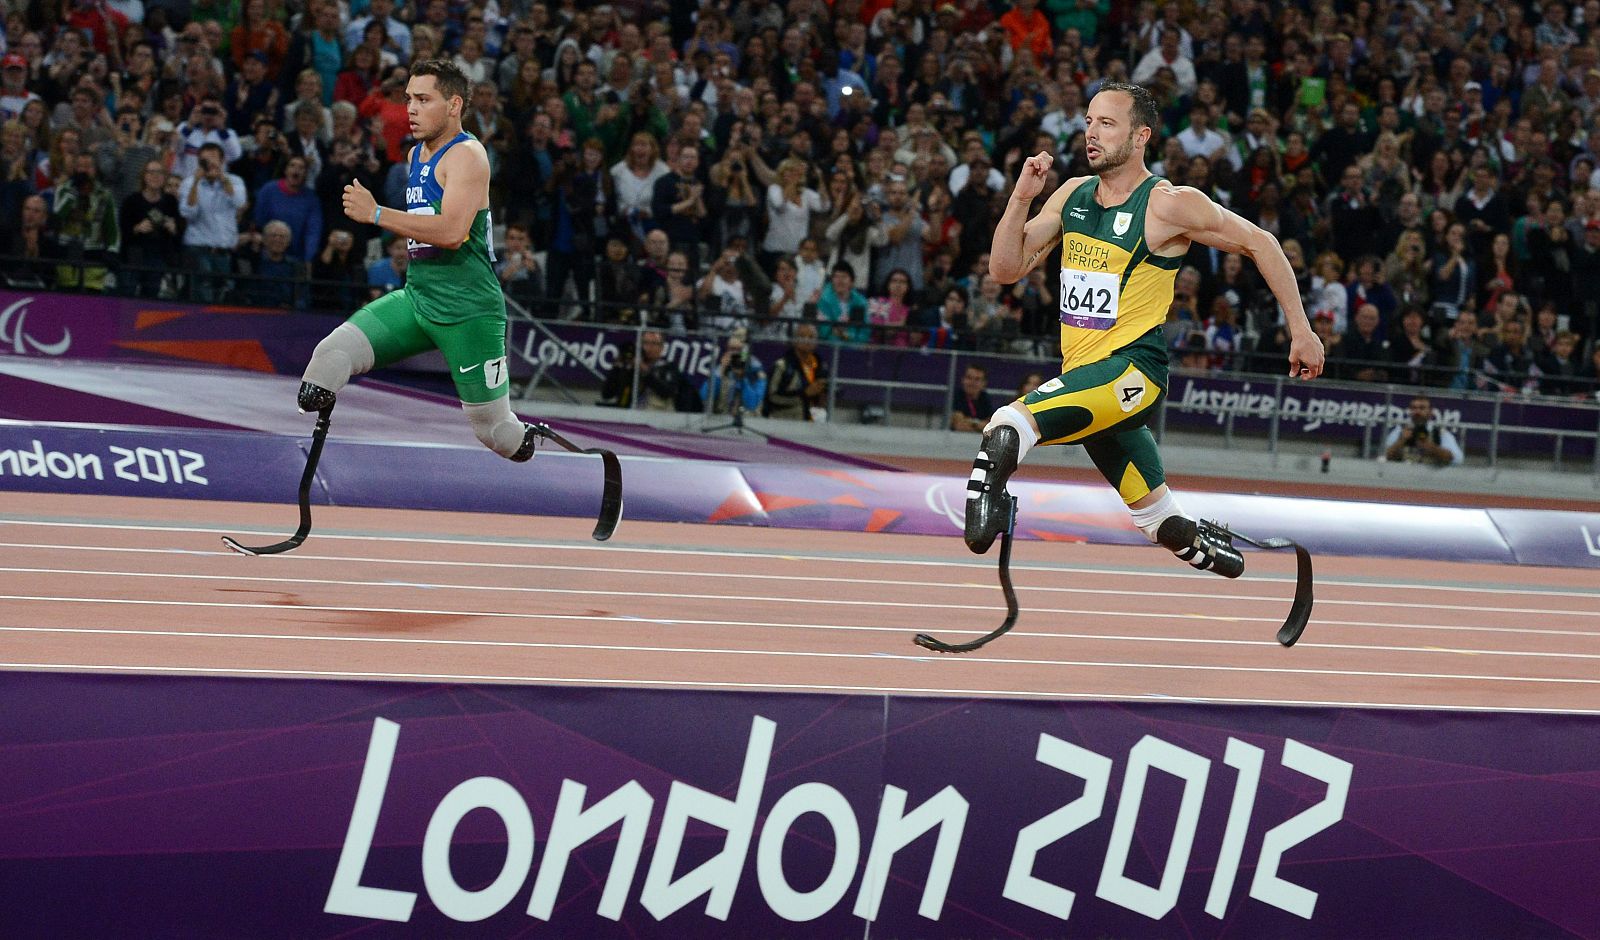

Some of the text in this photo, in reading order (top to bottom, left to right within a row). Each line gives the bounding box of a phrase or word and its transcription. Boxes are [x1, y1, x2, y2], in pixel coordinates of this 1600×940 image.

[1067, 252, 1109, 271] AFRICA
[1069, 239, 1110, 260] SOUTH
[1062, 283, 1112, 314] 2642
[522, 328, 620, 371] Londo
[491, 359, 501, 385] 7
[1121, 386, 1144, 403] 4
[1180, 379, 1276, 425] Inspire
[1281, 396, 1301, 421] a
[108, 445, 209, 486] 2012
[323, 714, 1354, 922] London 2012
